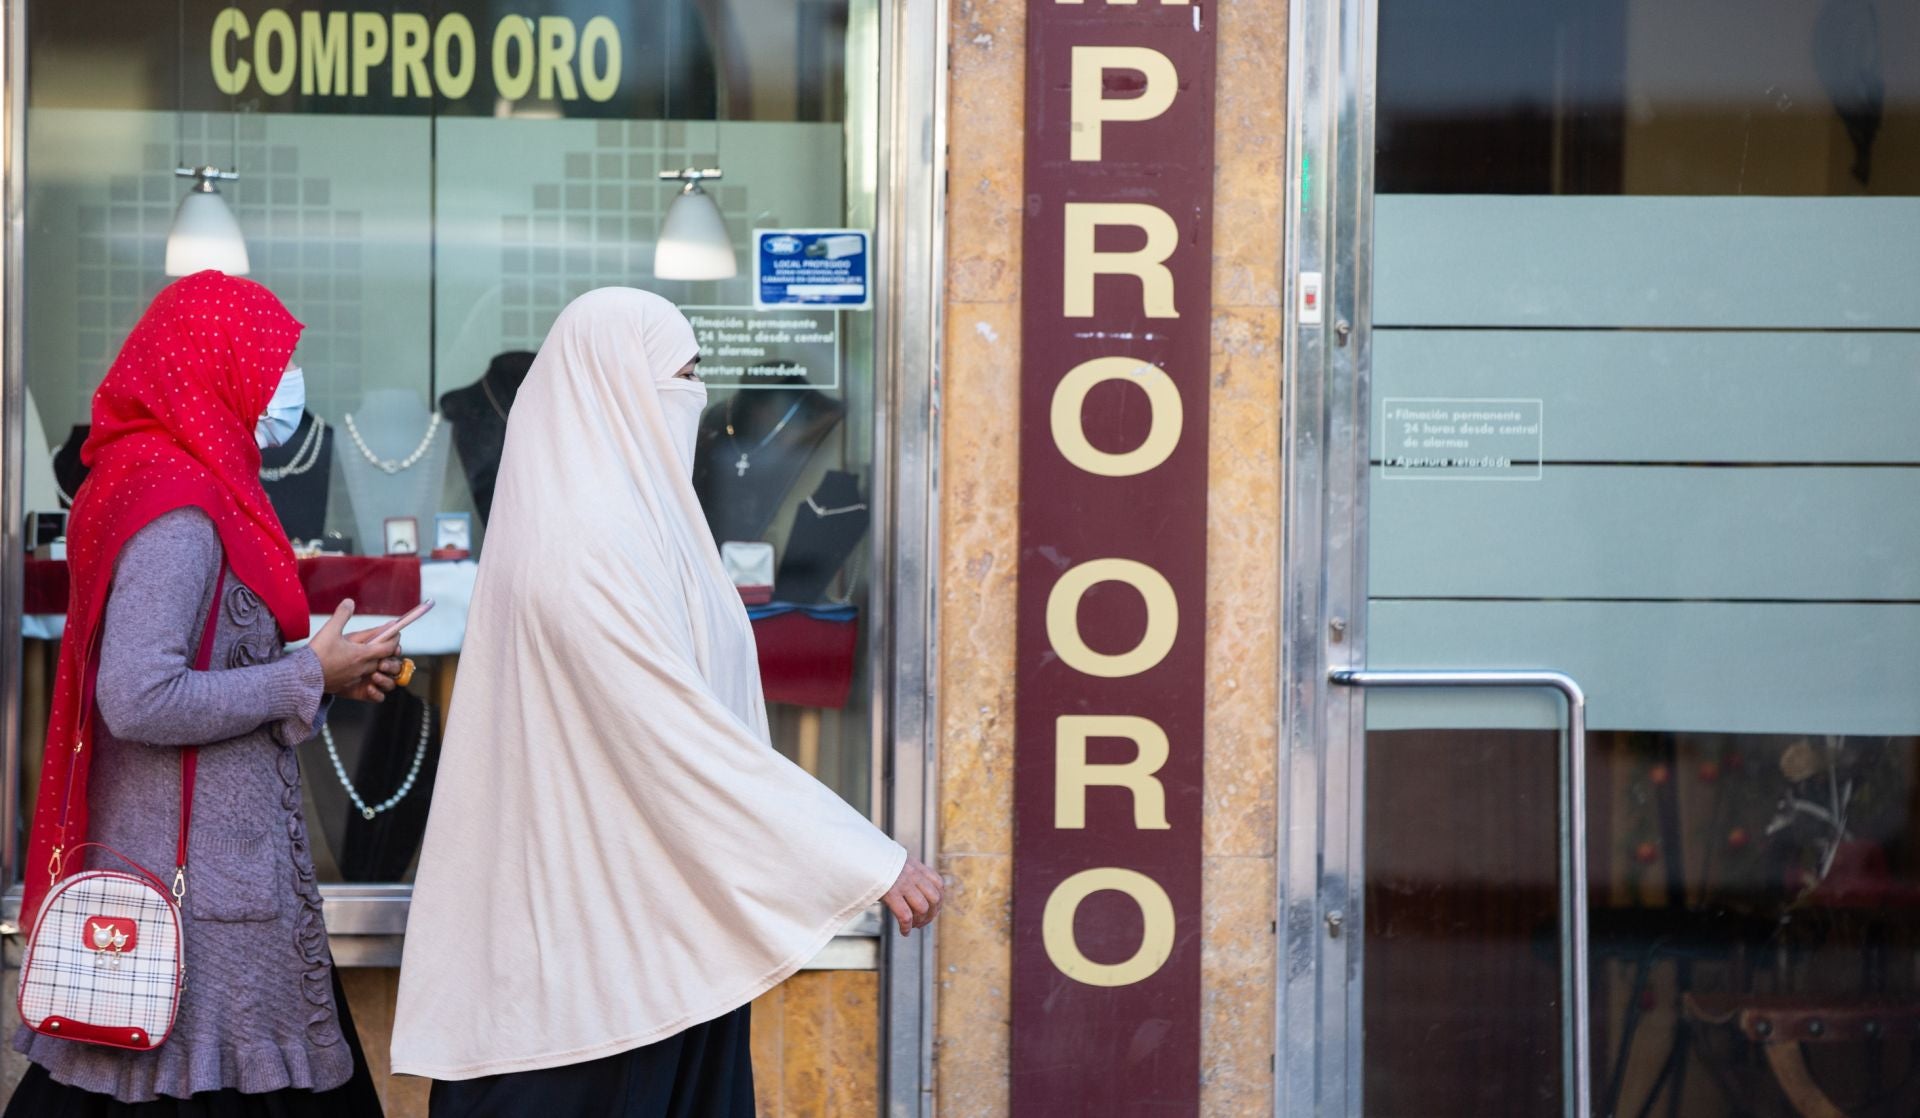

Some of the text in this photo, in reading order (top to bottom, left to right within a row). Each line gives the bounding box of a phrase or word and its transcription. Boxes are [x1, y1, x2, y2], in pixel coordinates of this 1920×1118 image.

[211, 7, 622, 102] COMPRO ORO
[773, 259, 851, 269] LOCAL PROTEGIDO
[691, 316, 817, 331] Filmación permanente
[699, 330, 835, 344] 24 horas desde central
[699, 344, 765, 357] de alarmas
[1395, 408, 1522, 422] Filmación permanente
[1403, 422, 1539, 436] 24 horas desde central
[1403, 436, 1470, 449] de alarmas
[1396, 455, 1449, 469] Apertura
[1043, 0, 1190, 987] PRO ORO
